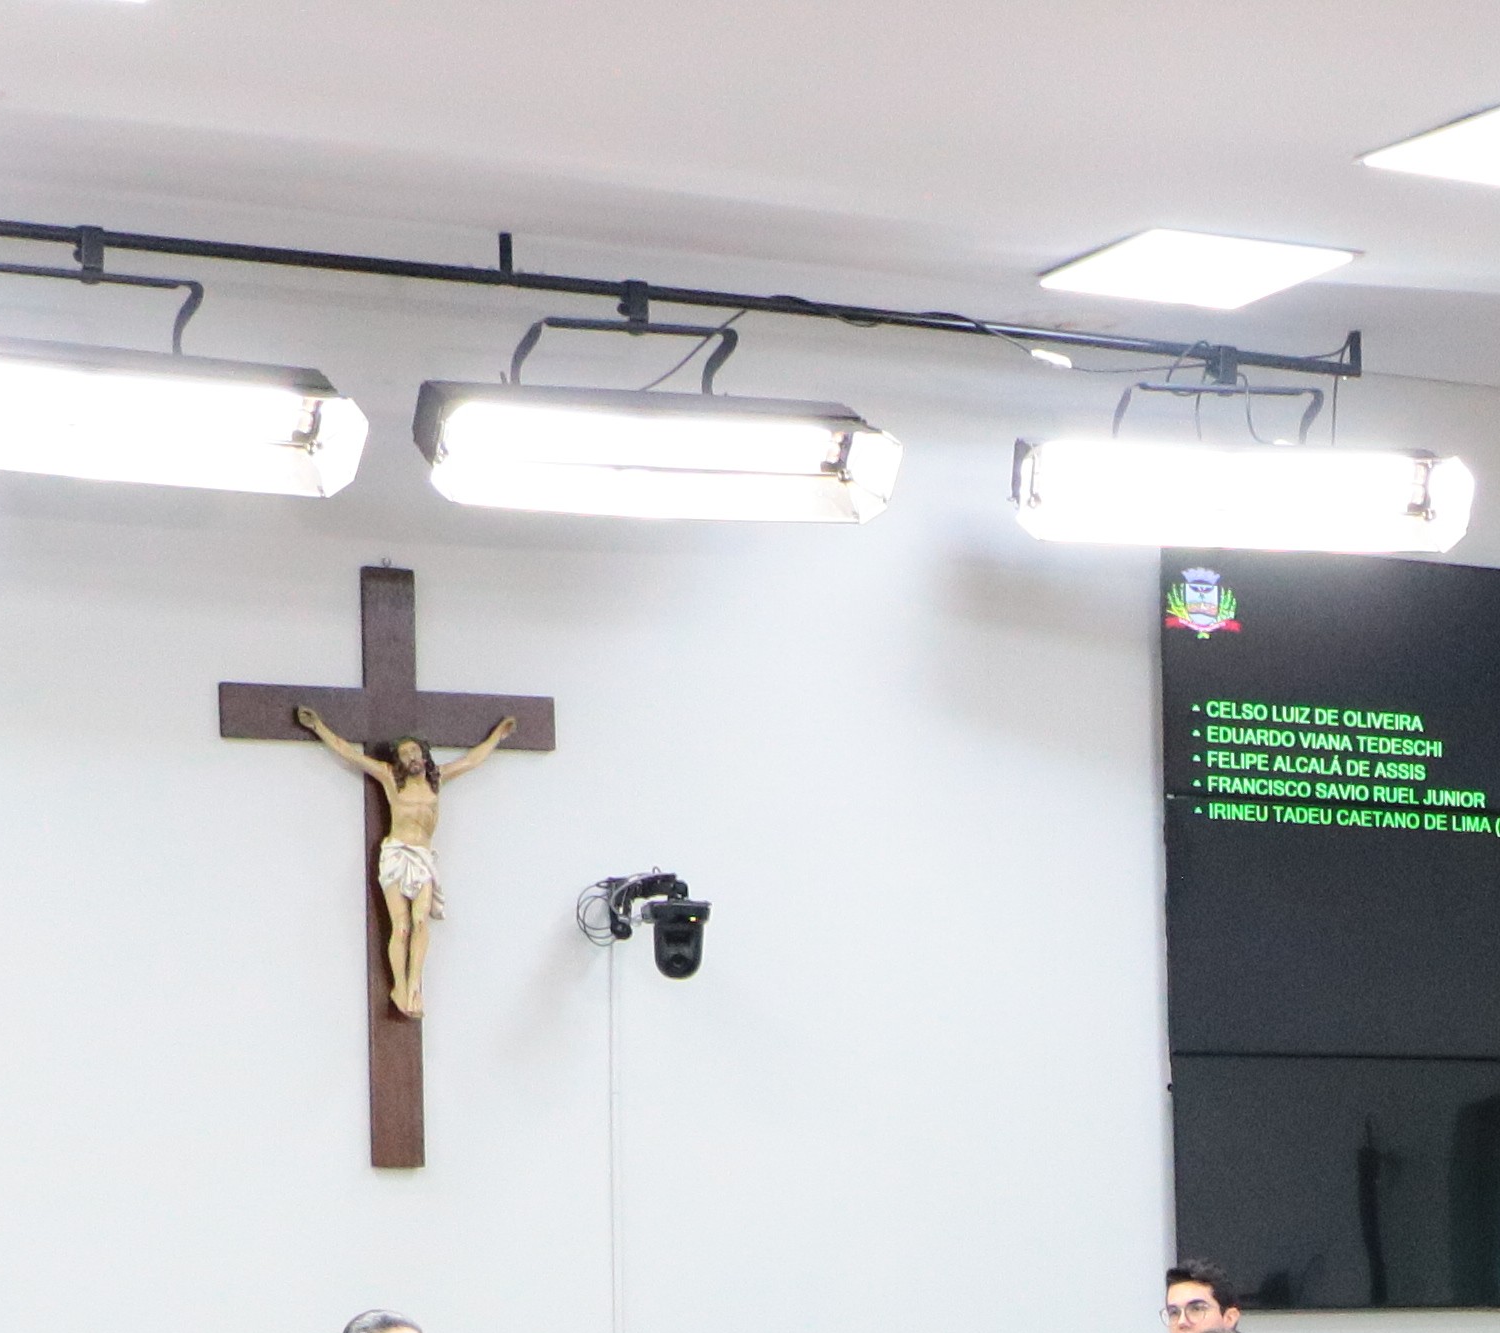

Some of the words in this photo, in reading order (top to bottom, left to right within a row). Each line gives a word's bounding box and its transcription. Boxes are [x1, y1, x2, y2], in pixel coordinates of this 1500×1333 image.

[1206, 700, 1268, 721] CELSO
[1272, 705, 1309, 725] LUIZ
[1313, 708, 1339, 728] DE
[1343, 710, 1424, 732] OLIVEIRA
[1206, 725, 1295, 748] EDUARDO
[1299, 731, 1353, 751] VIANA
[1356, 734, 1443, 757] TEDESCHI
[1207, 751, 1269, 772] FELIPE
[1273, 754, 1342, 776] ALCALÁ
[1347, 759, 1370, 778] DE
[1374, 761, 1426, 781] ASSIS
[1207, 775, 1311, 798] FRANCISCO
[1315, 781, 1368, 802] SAVIO
[1373, 785, 1419, 805] RUEL
[1422, 788, 1485, 809] JUNIOR
[1208, 802, 1268, 823] IRINEU
[1273, 805, 1332, 827] TADEU
[1336, 808, 1420, 831] CAETANO
[1424, 814, 1448, 832] DE
[1452, 815, 1492, 835] LIMA
